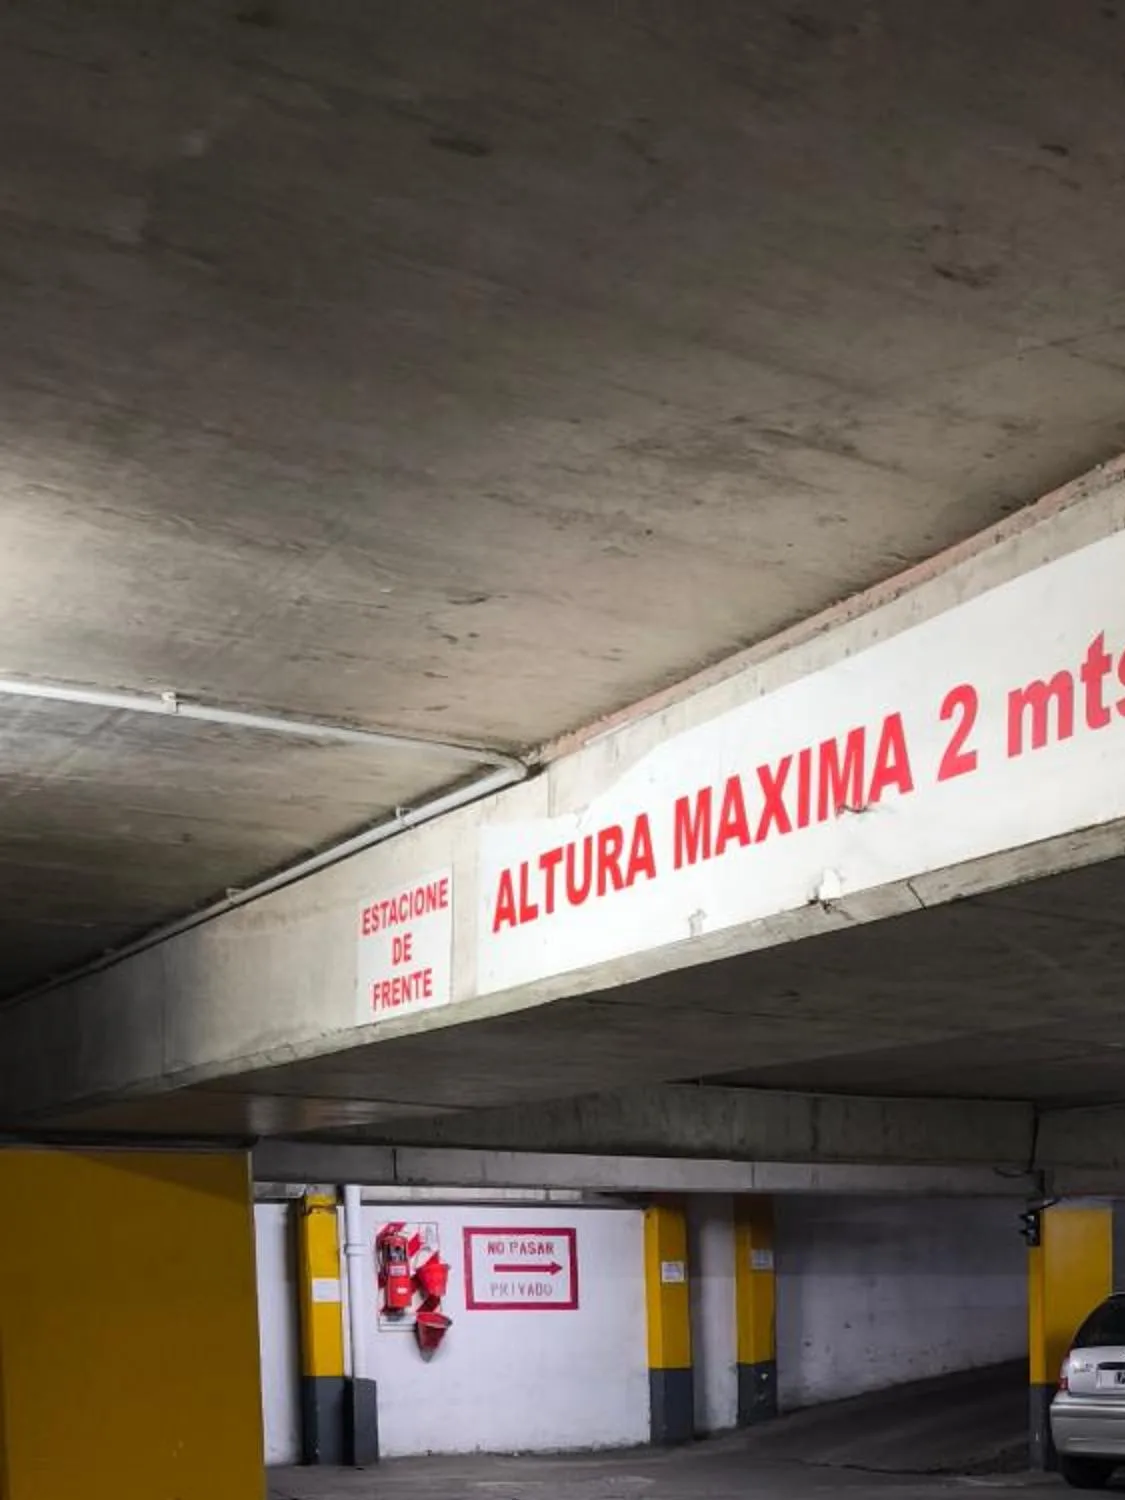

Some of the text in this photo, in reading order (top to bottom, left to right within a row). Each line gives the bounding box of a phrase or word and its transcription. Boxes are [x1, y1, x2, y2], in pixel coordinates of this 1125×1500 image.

[491, 812, 656, 935] ALTURA
[672, 711, 914, 871] MAXIMA
[936, 682, 980, 783] 2
[361, 878, 449, 936] ESTACIONE
[391, 932, 412, 966] DE
[372, 967, 433, 1010] FRENTE
[487, 1241, 555, 1256] NO PASAR
[489, 1281, 553, 1297] PRIVADO
